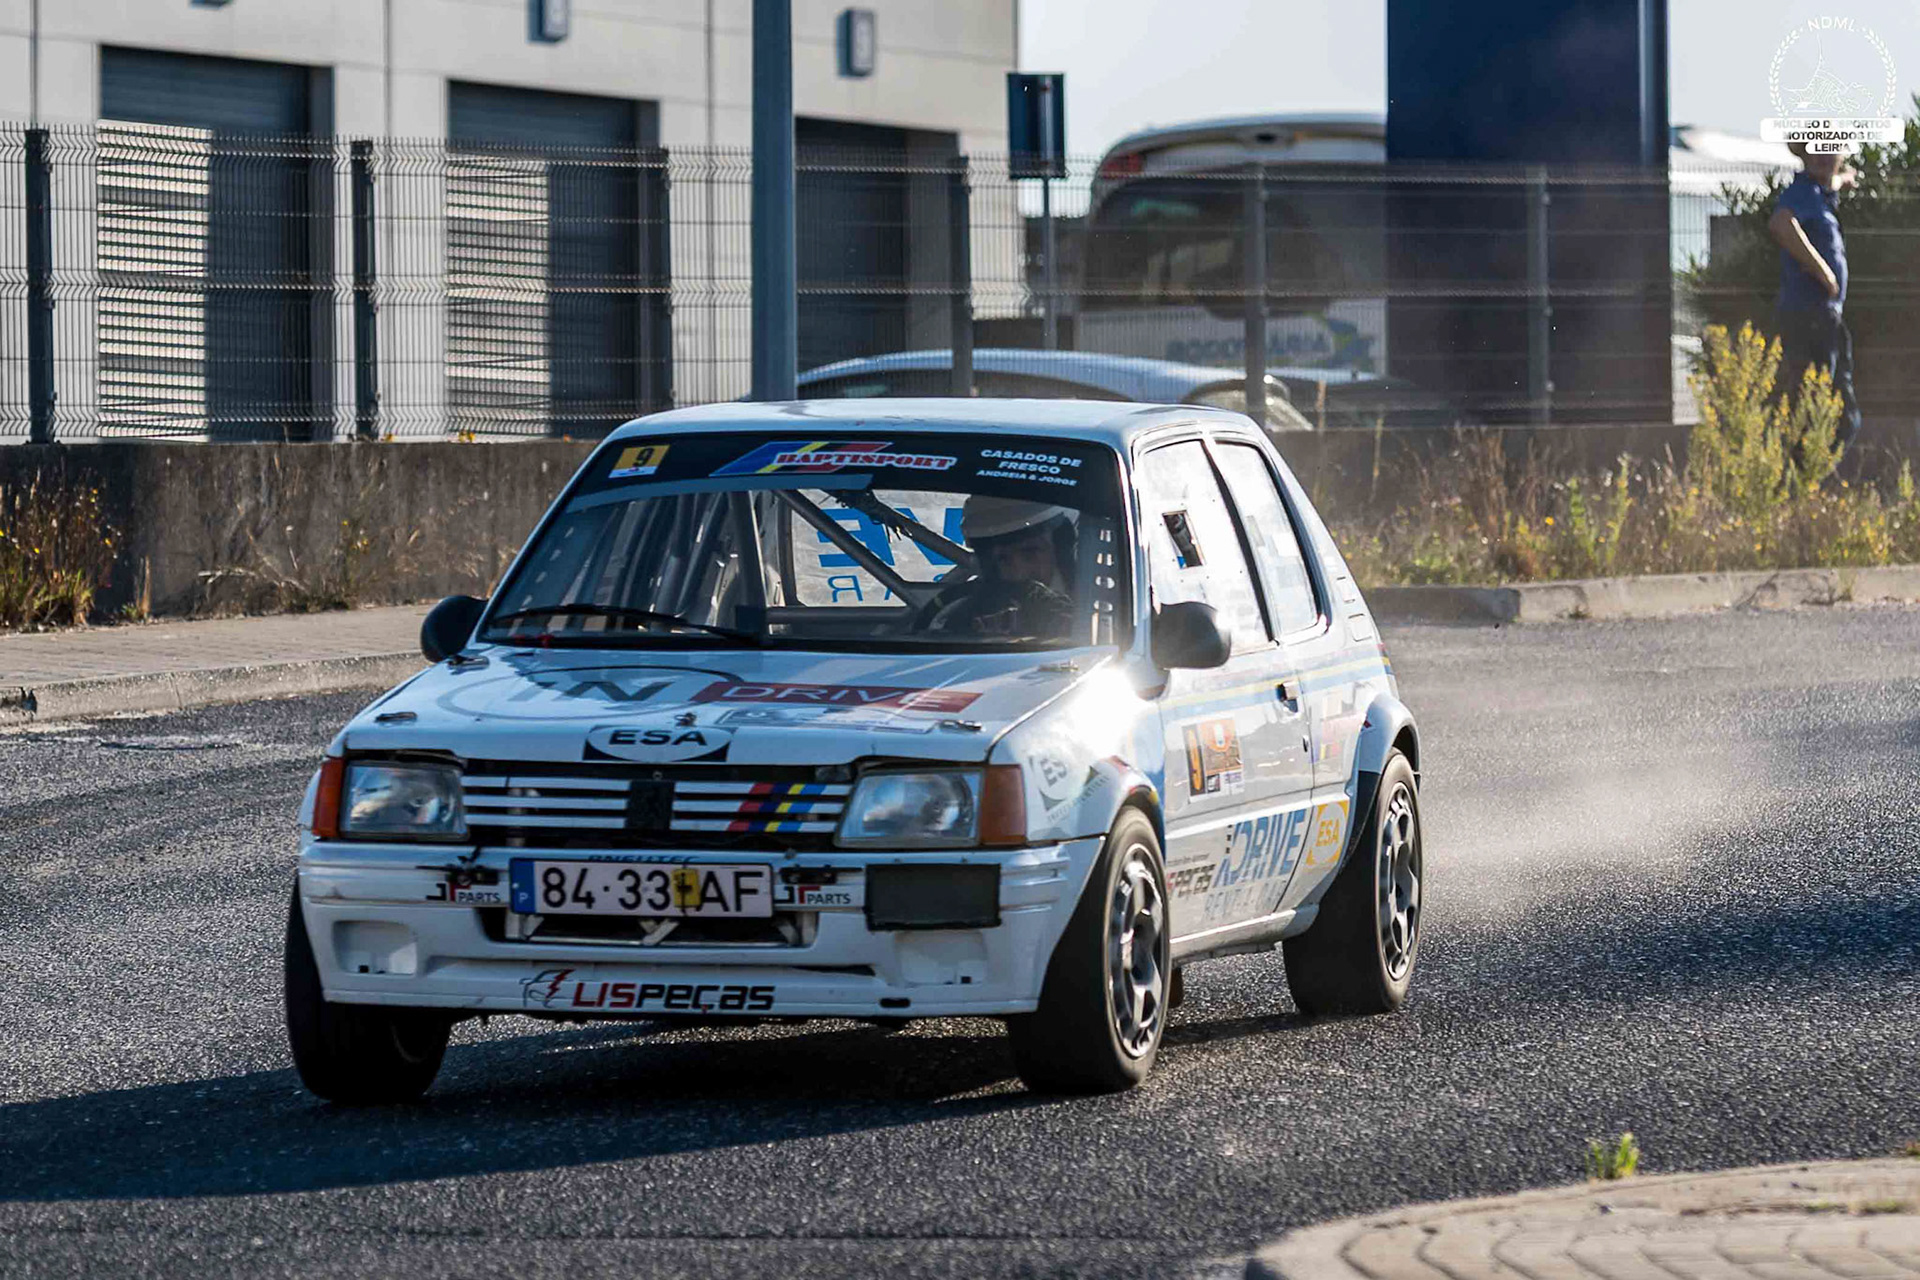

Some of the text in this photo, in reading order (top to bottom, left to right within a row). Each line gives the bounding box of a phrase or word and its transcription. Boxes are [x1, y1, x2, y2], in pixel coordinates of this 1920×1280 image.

[632, 447, 655, 468] 9
[981, 449, 1082, 467] CASADOS DE
[998, 461, 1061, 474] FRESCO
[976, 469, 1026, 480] ANDREIA
[1038, 475, 1077, 486] JORGE
[721, 685, 952, 708] DRIVE
[608, 729, 709, 746] ESA
[1040, 757, 1069, 788] ES
[1315, 818, 1340, 847] ESA
[807, 893, 851, 904] PARTS
